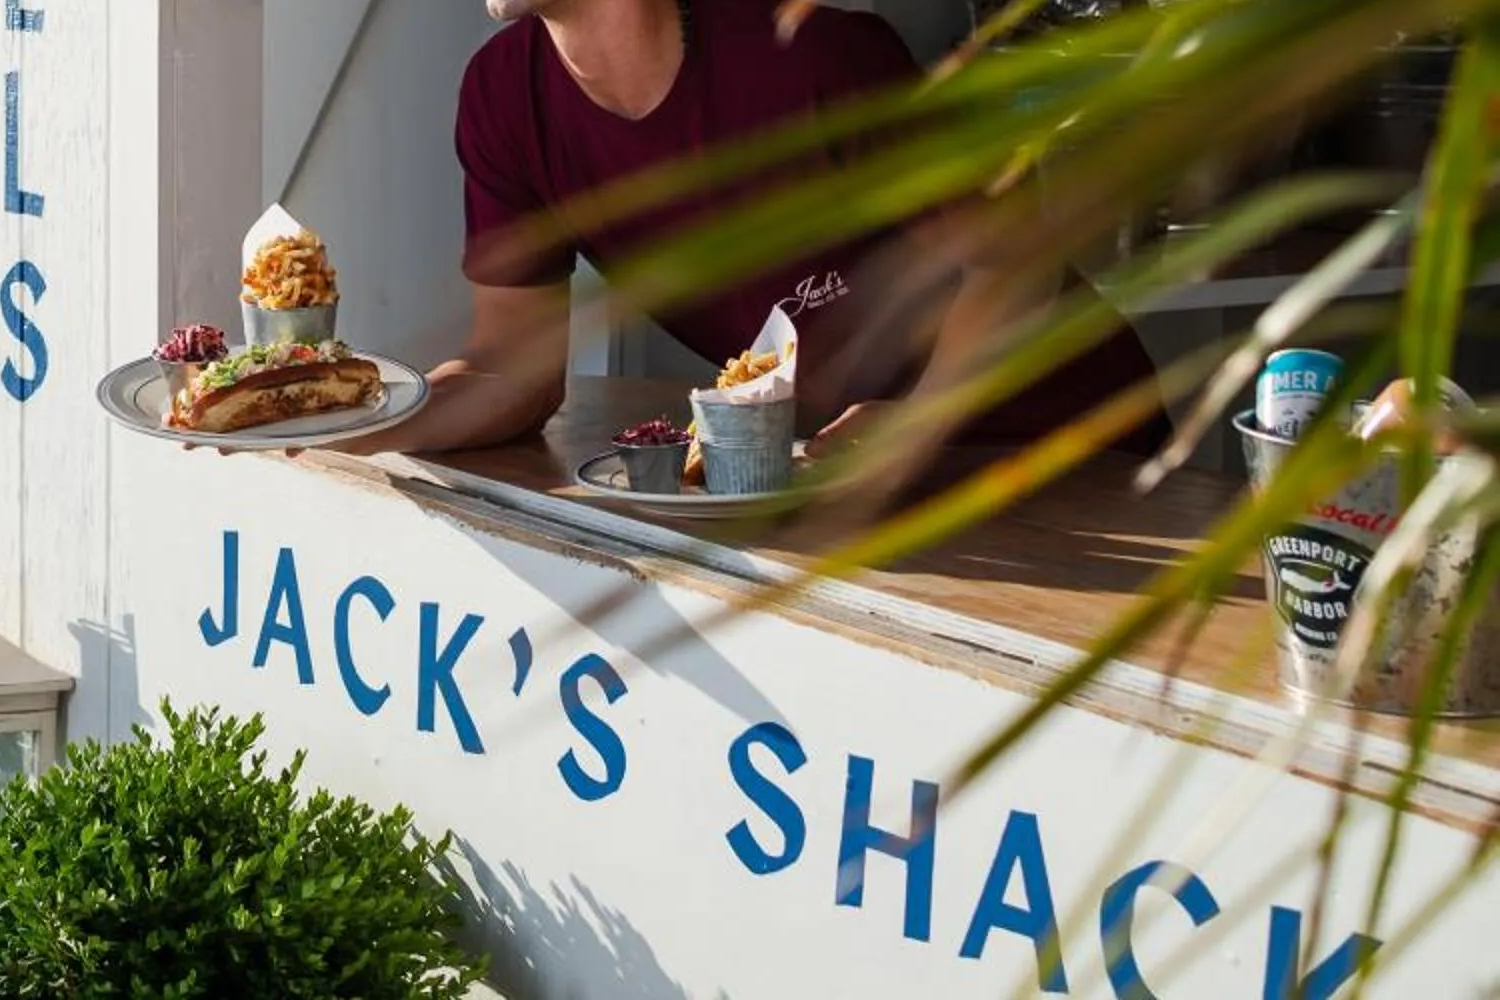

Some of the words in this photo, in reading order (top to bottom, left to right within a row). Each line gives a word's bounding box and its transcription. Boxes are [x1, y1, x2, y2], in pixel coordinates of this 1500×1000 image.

[776, 269, 845, 317] Jack's
[1269, 535, 1361, 571] GREENPORT
[200, 530, 628, 801] JACK'S
